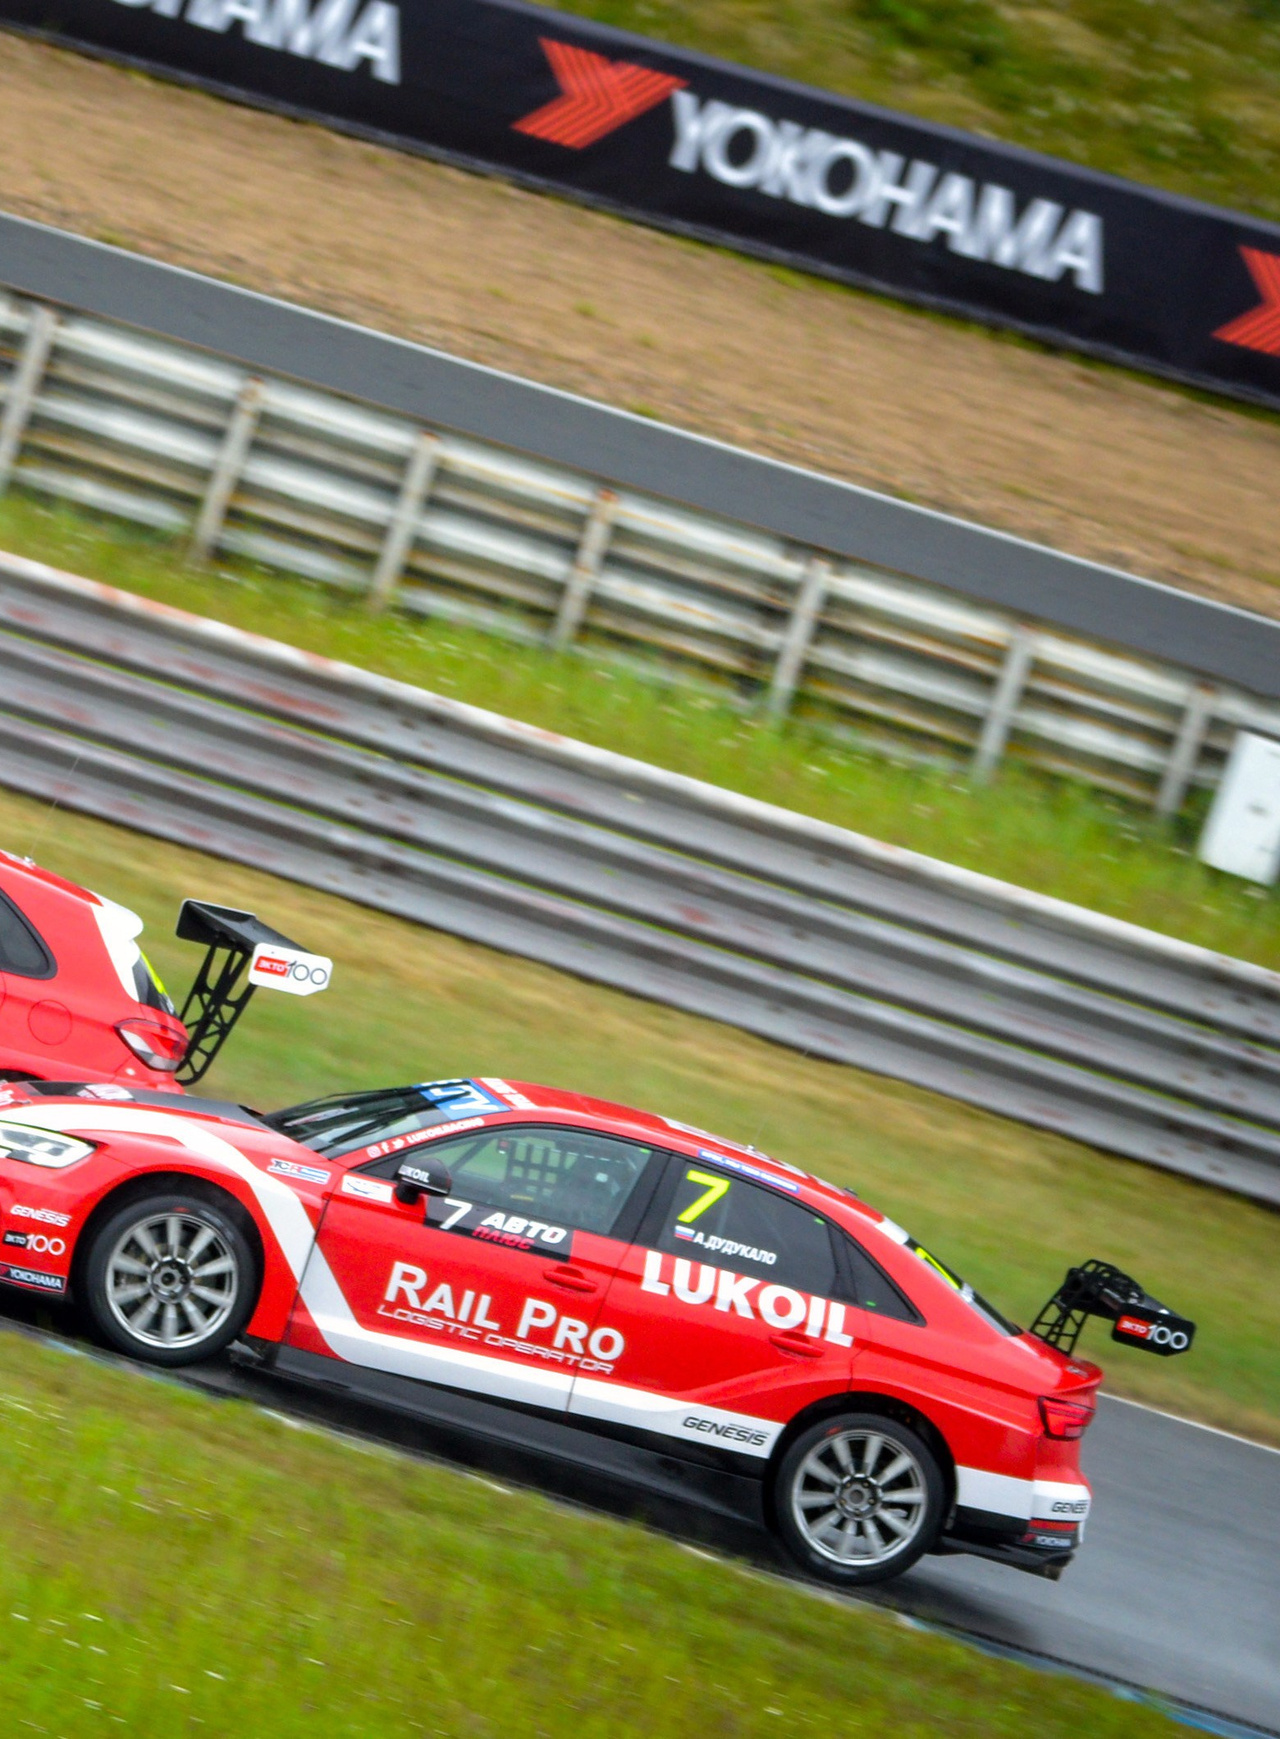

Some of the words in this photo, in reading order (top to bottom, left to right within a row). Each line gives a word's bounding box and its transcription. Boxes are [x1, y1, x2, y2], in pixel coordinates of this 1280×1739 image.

[669, 89, 1104, 296] YOKOHAMA
[286, 960, 328, 986] 100
[677, 1169, 731, 1224] 7
[10, 1204, 71, 1227] GENESIS
[439, 1198, 473, 1230] 7
[480, 1212, 568, 1244] АВТО
[26, 1233, 66, 1256] 100
[472, 1226, 536, 1249] ПЛЮС
[10, 1267, 62, 1289] YOKOHAMA
[640, 1249, 854, 1348] LUKOIL
[377, 1304, 483, 1341] LOGISTIC
[484, 1333, 615, 1375] OPERATOR
[1146, 1324, 1189, 1350] 100
[682, 1416, 767, 1447] GENESIS
